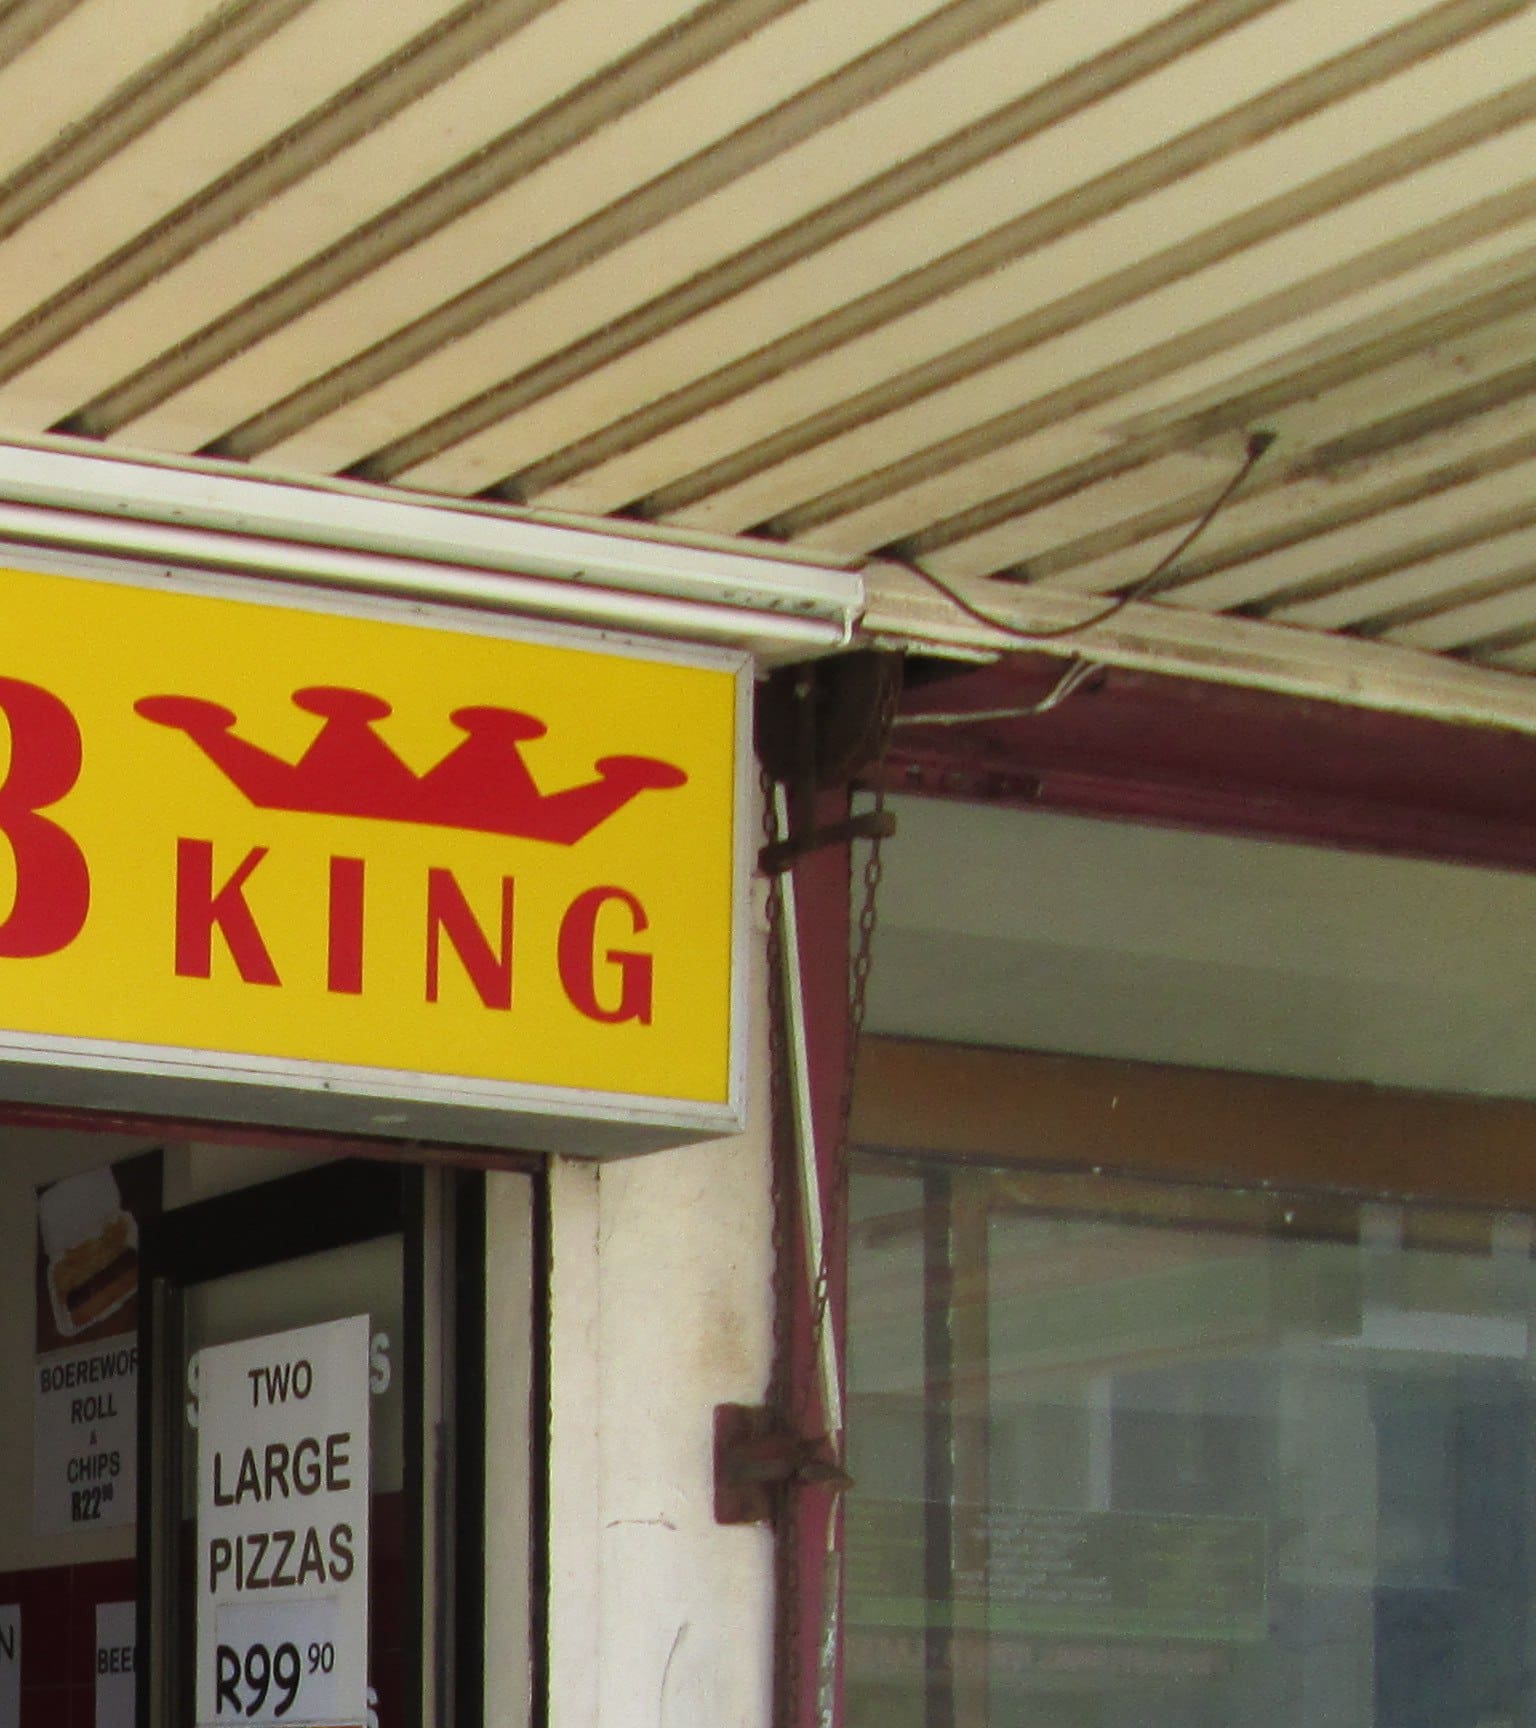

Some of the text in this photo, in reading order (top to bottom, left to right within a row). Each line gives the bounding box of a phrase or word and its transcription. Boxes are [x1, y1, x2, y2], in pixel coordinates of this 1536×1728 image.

[173, 836, 655, 1027] KING
[39, 1347, 139, 1394] BOEREWOR
[247, 1358, 313, 1408] TWO
[70, 1393, 117, 1424] ROLL
[66, 1450, 122, 1485] CHIPS
[212, 1432, 351, 1508] LARGE
[209, 1522, 355, 1595] PIZZAS
[97, 1645, 137, 1675] BEE
